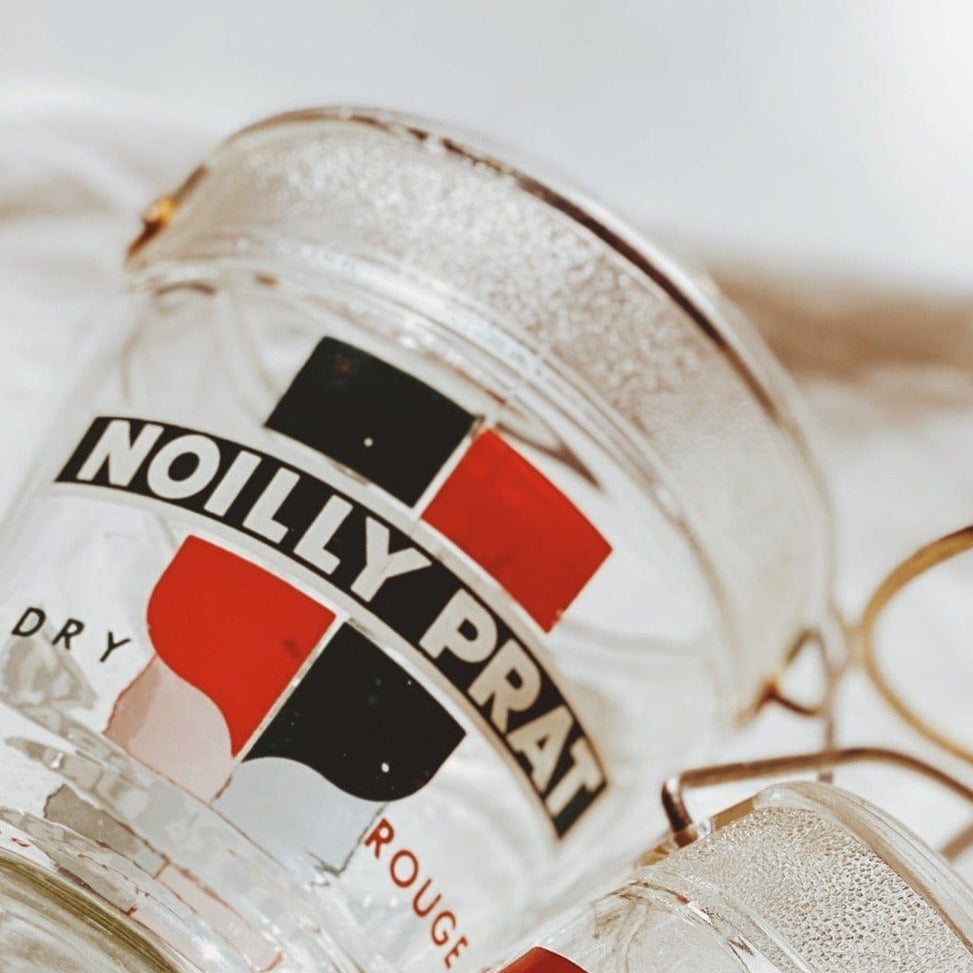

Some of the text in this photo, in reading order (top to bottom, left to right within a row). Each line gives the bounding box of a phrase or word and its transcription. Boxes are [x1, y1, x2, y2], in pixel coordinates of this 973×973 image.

[12, 607, 131, 664] DRY
[77, 419, 600, 817] NOILLY PRAT
[364, 819, 469, 968] ROUGE
